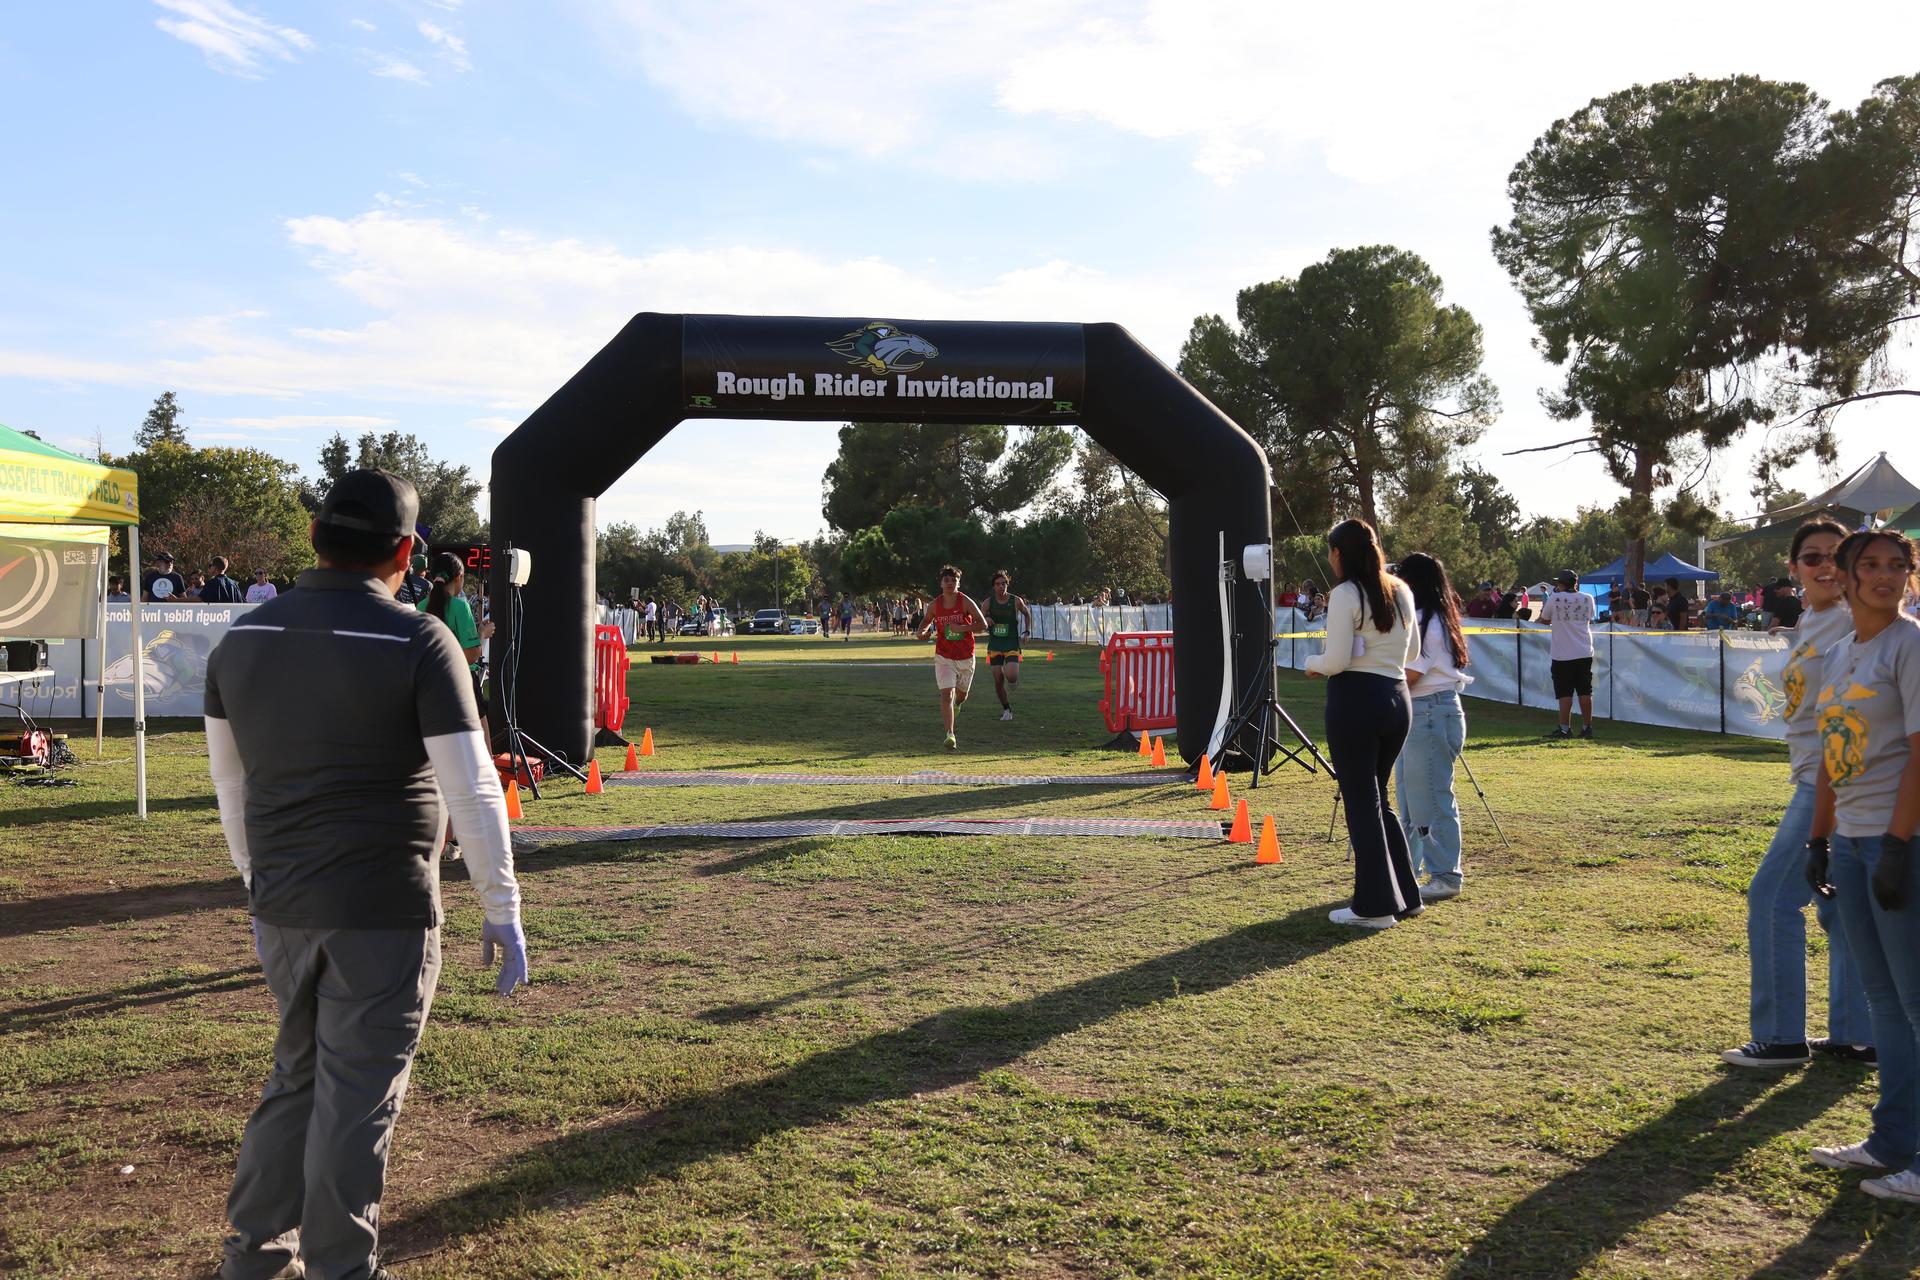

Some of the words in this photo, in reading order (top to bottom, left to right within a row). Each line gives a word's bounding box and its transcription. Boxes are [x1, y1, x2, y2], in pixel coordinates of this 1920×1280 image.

[717, 371, 805, 400] Rough
[815, 372, 888, 397] Rider
[897, 374, 1054, 399] Invitational
[95, 479, 121, 505] FIELD
